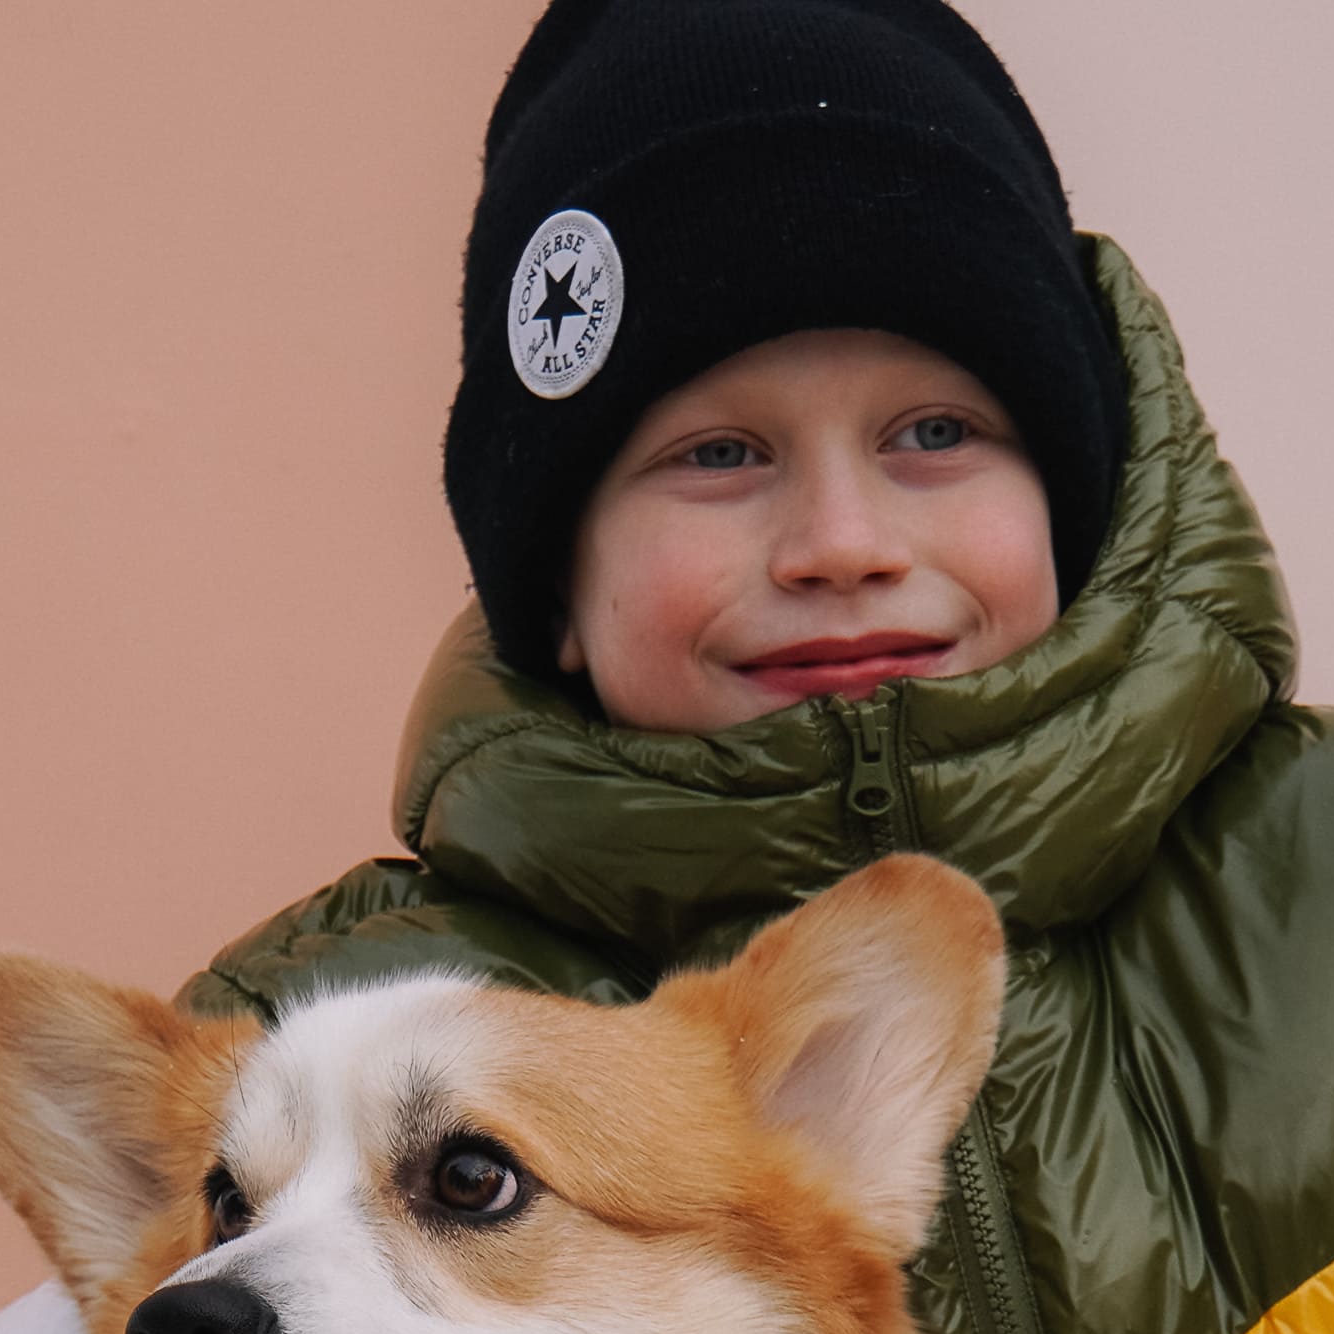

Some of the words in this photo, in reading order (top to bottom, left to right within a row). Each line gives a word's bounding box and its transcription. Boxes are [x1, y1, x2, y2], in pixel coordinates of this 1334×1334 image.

[519, 233, 585, 325] CONVERSE
[542, 353, 573, 373] ALL
[575, 299, 605, 359] STAR
